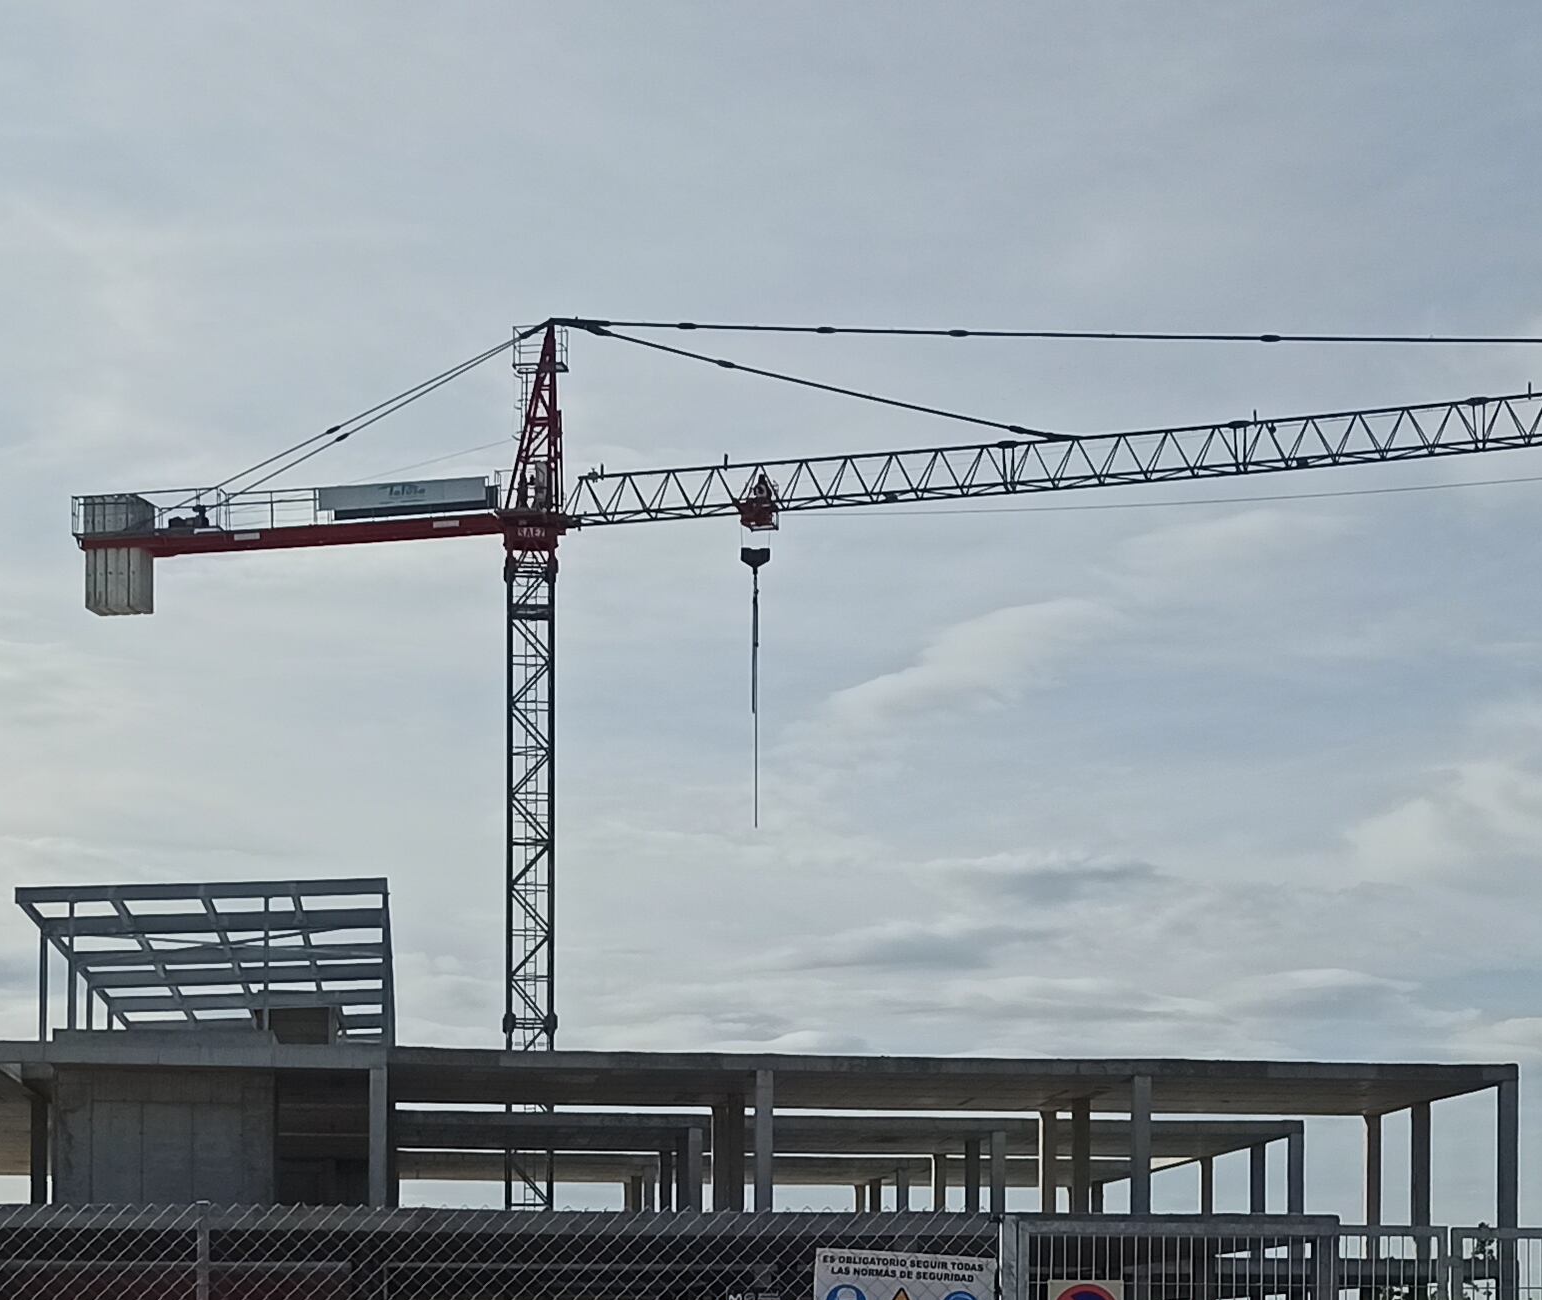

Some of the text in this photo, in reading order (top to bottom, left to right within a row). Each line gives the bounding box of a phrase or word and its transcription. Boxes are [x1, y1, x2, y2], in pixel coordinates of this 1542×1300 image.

[823, 1255, 984, 1272] ES OBLIGATORIO SEGUIR TODAS
[831, 1267, 974, 1282] LAS NORMAS DE SEGURIDAD
